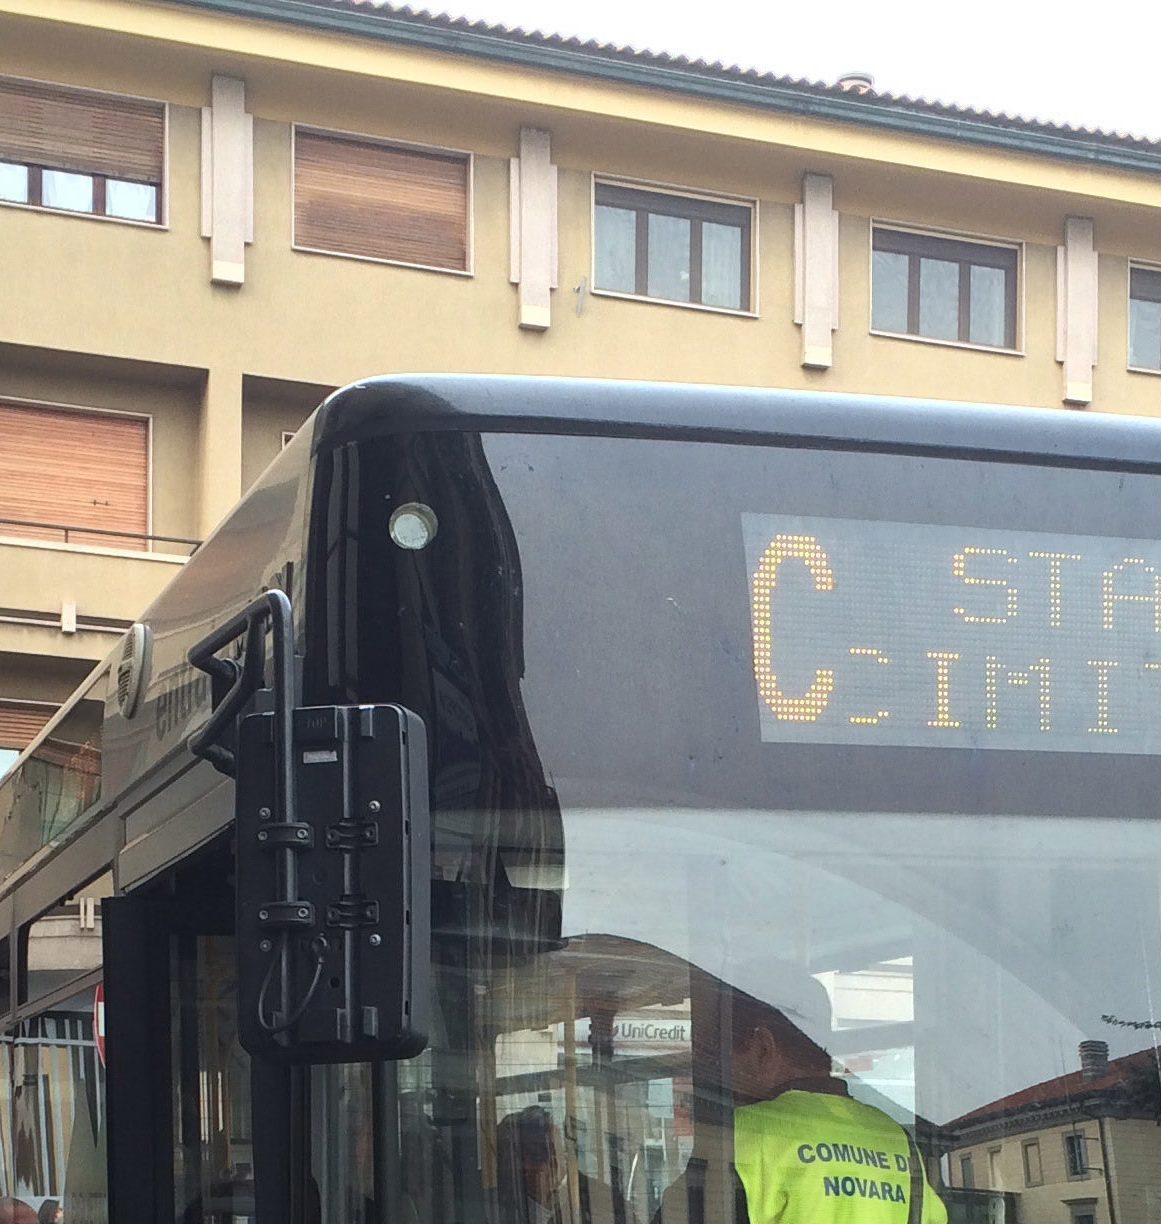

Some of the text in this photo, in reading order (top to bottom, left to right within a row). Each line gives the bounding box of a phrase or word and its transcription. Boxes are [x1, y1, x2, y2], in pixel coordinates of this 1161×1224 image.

[753, 534, 835, 722] C
[622, 1022, 686, 1041] UniCredit
[797, 1143, 890, 1170] COMUNE
[824, 1176, 906, 1205] NOVARA
